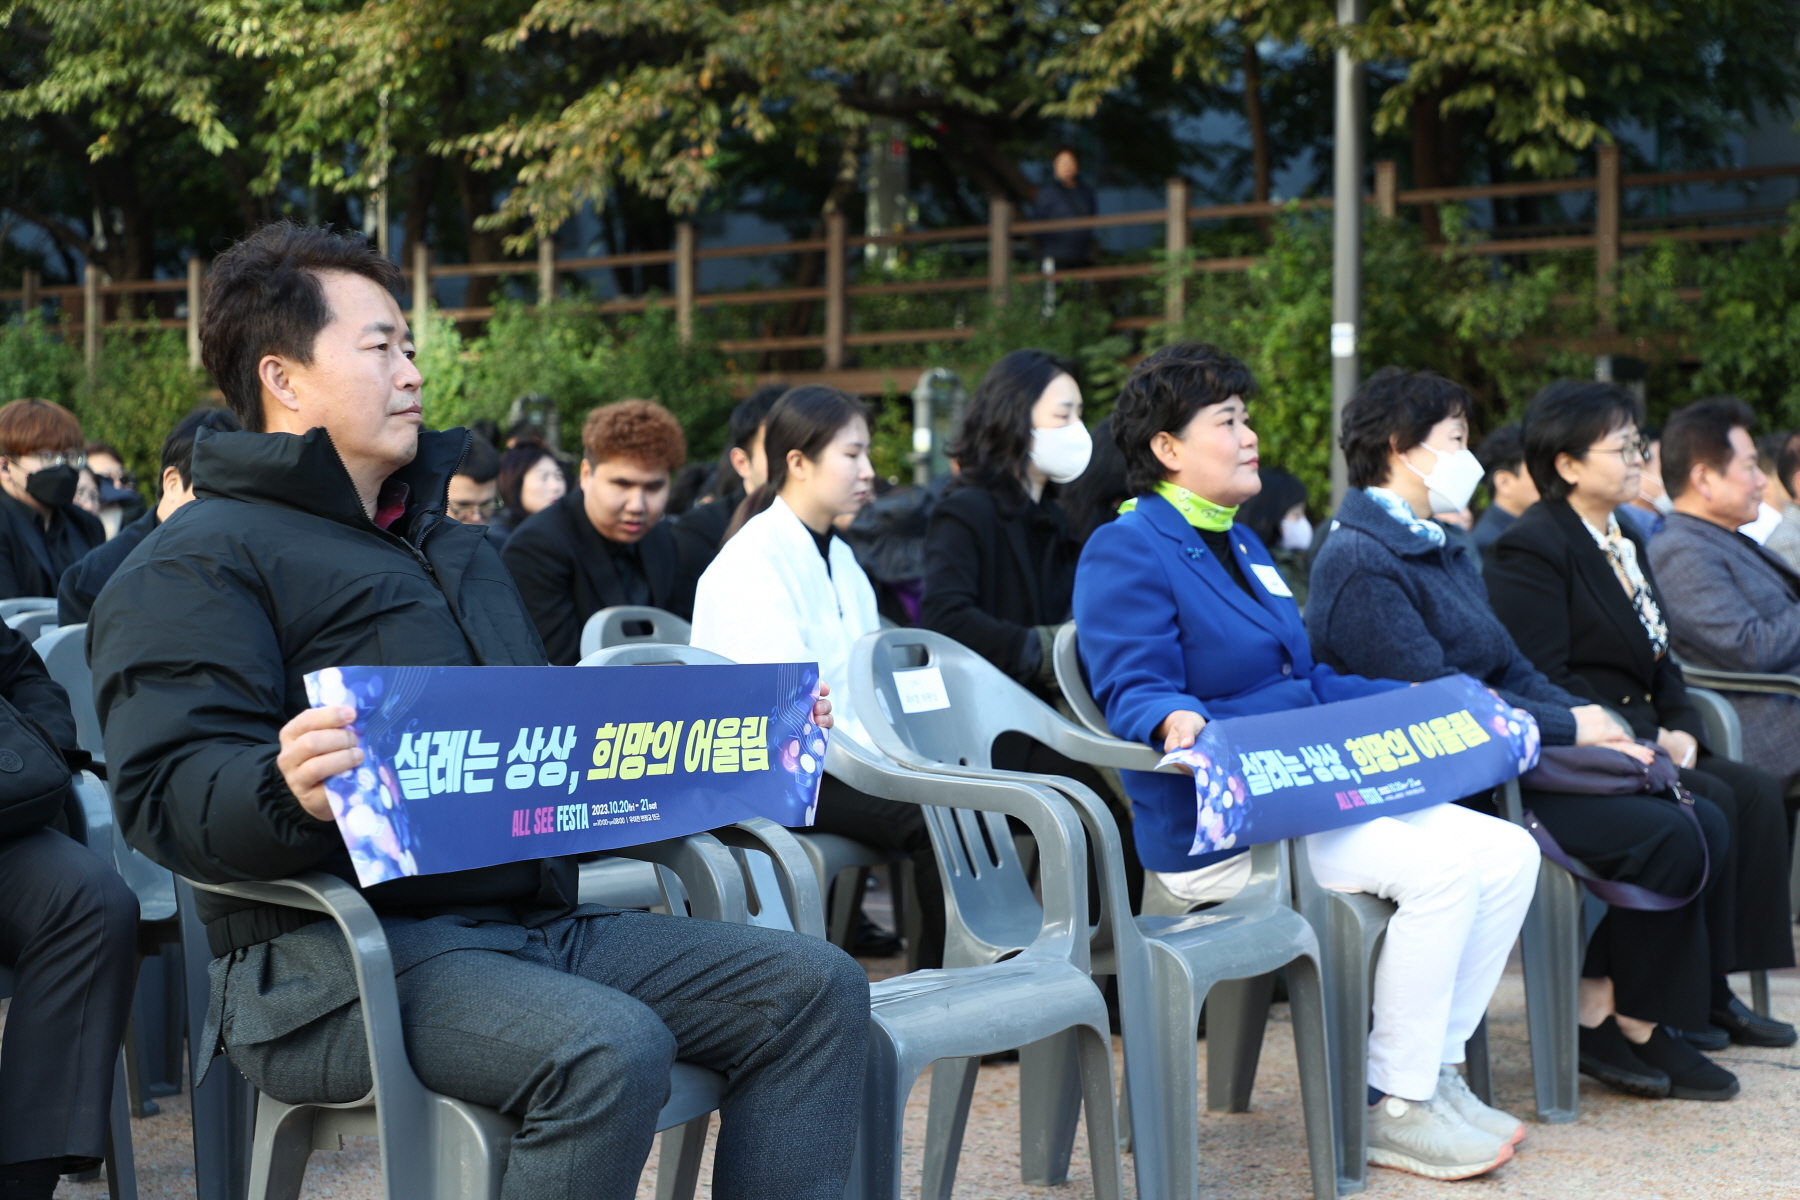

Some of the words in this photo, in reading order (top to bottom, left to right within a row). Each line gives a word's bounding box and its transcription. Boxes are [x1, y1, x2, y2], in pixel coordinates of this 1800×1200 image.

[394, 729, 500, 801] 설레는
[505, 725, 580, 795] 상상,
[587, 720, 685, 781] 희망의
[684, 716, 770, 774] 어울림
[1239, 749, 1315, 797] 설레는
[1298, 743, 1362, 785] 상상,
[1343, 728, 1421, 776] 희망의
[1408, 709, 1491, 759] 어울림
[512, 809, 531, 837] ALL
[533, 806, 554, 835] SEE
[556, 803, 590, 832] FESTA
